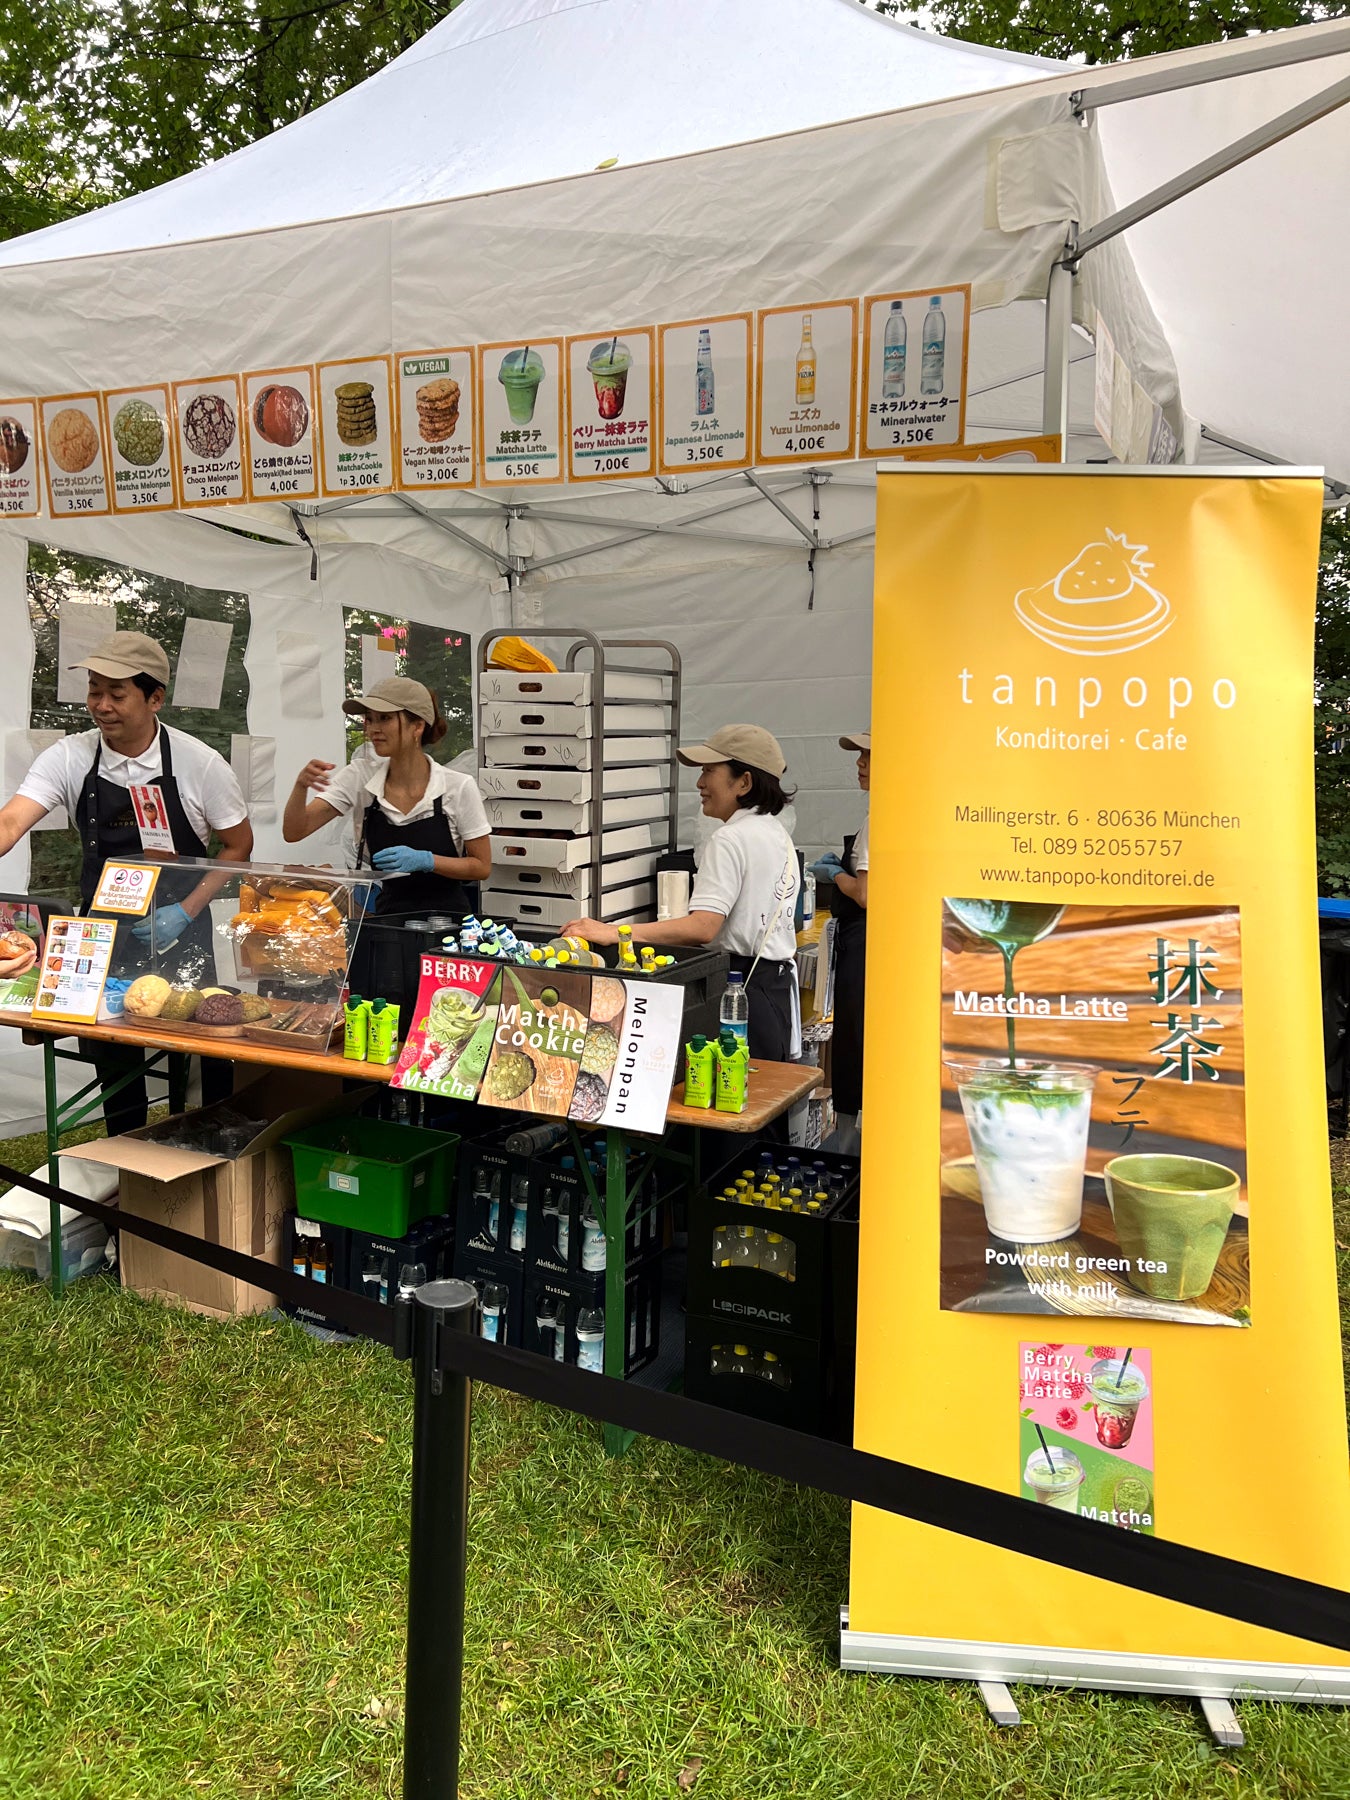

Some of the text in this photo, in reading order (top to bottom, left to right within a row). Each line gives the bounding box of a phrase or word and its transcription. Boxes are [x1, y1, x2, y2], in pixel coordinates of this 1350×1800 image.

[418, 361, 446, 373] VEGAN
[869, 397, 959, 414] ミネラルウォーター
[789, 408, 821, 421] ユズカ
[880, 414, 946, 427] Mineralwater
[573, 420, 648, 438] ベリー抹茶ラテ
[690, 419, 720, 432] ラムネ
[769, 421, 841, 435] Yuzu Limonade
[500, 429, 542, 444] 抹茶ラテ
[574, 436, 648, 450] Berry Matcha Latte
[665, 430, 745, 446] Japanese Limonade
[785, 436, 825, 452] 4,00€
[892, 428, 934, 445] 3,50€
[496, 444, 547, 454] Matcha Latte
[686, 446, 724, 462] 3,50€
[183, 461, 241, 475] チョコメロンパン
[337, 462, 382, 472] MatchaCookie
[405, 456, 470, 468] Vegan Miso Cookie
[505, 463, 539, 477] 6,50€
[594, 457, 629, 472] 7,00€
[186, 474, 239, 485] Choco Melonpan
[339, 473, 380, 487] 1p 3,00€
[416, 468, 459, 482] 1p 3,00€
[0, 479, 30, 489] そばパン
[53, 487, 105, 496] Vanilla Melonpan
[116, 481, 171, 491] Matcha Melonpan
[200, 485, 228, 498] 3,50€
[270, 480, 298, 492] 4,00€
[68, 498, 93, 510] 3,50€
[132, 492, 158, 504] 3,50€
[958, 667, 1237, 719] tanpopo
[995, 726, 1188, 751] Konditorei Cafe
[553, 744, 574, 764] Ya
[484, 776, 506, 793] Ya
[955, 805, 1241, 829] Maillingerstr. 6 80636 München
[1011, 836, 1037, 855] Tel.
[1043, 838, 1078, 856] 089
[979, 866, 1215, 888] www.tanpopo-konditorei.de
[421, 958, 484, 983] BERRY
[7, 993, 34, 1005] Matc
[953, 990, 1129, 1019] Matcha Latte
[497, 1003, 588, 1032] Matcha
[1147, 937, 1226, 1084] 抹茶
[495, 1024, 585, 1054] Cookie
[615, 997, 648, 1114] Melonpan
[401, 1071, 475, 1099] Matcha
[1110, 1067, 1149, 1148] ラテ
[985, 1249, 1169, 1275] Powderd green tea
[1027, 1278, 1119, 1301] with milk
[1024, 1350, 1074, 1370] Berry
[1024, 1366, 1094, 1385] Matcha
[1024, 1383, 1073, 1400] Latte
[1080, 1506, 1153, 1526] Matcha
